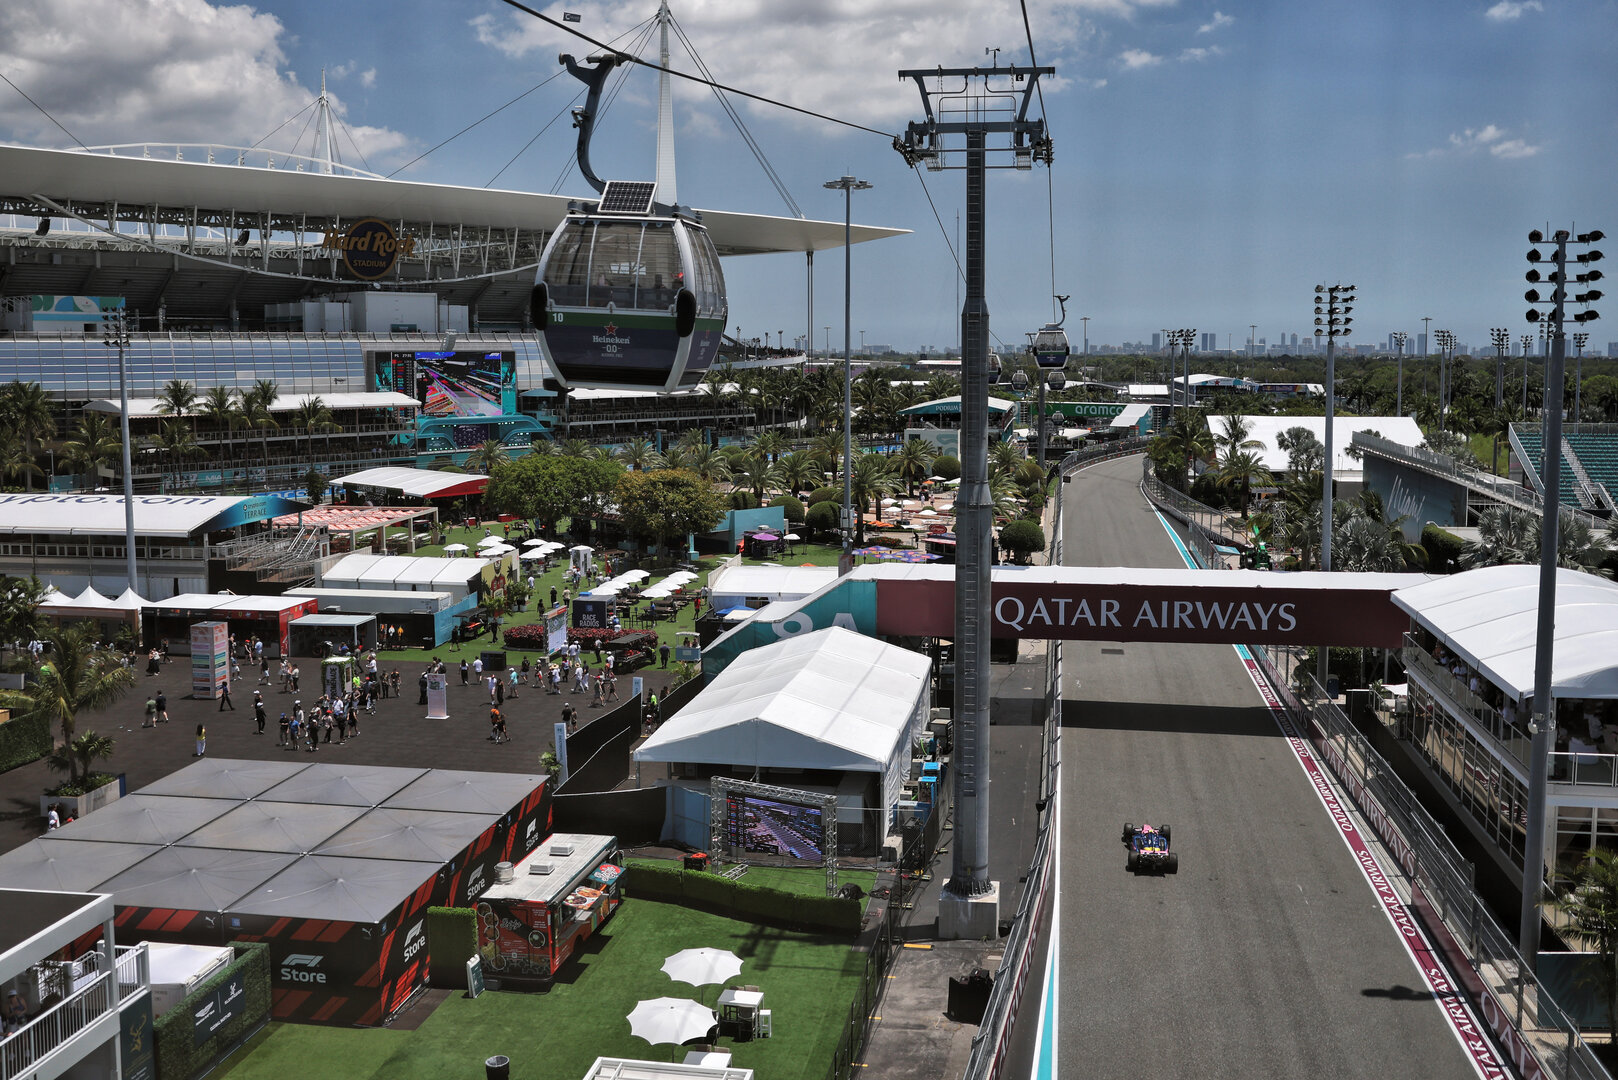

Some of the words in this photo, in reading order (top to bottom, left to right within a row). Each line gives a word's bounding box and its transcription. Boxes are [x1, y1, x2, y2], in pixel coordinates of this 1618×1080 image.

[322, 229, 372, 251] Hard
[372, 231, 416, 257] Rock
[353, 260, 386, 268] STADIUM
[553, 313, 564, 323] 10
[593, 336, 630, 345] Heineken
[1075, 404, 1122, 415] aramco
[1387, 475, 1426, 523] Miami
[244, 508, 267, 520] TERRACE
[579, 620, 600, 628] RADIOS
[995, 597, 1122, 631] QATAR
[1133, 601, 1297, 632] AIRWAYS
[1310, 771, 1338, 804] AIRWAYS
[1322, 740, 1356, 797] QATAR
[1358, 789, 1414, 877] AIRWAYS
[1329, 803, 1353, 831] QATAR
[525, 832, 539, 851] Store
[467, 863, 485, 887] F1
[1357, 850, 1391, 894] AIRWAYS
[467, 878, 486, 900] Store
[1383, 895, 1416, 937] QATAR
[404, 918, 424, 947] F1
[281, 953, 324, 967] F1
[404, 935, 426, 963] Store
[281, 968, 326, 984] Store
[1426, 968, 1478, 1036] AIRWAYS
